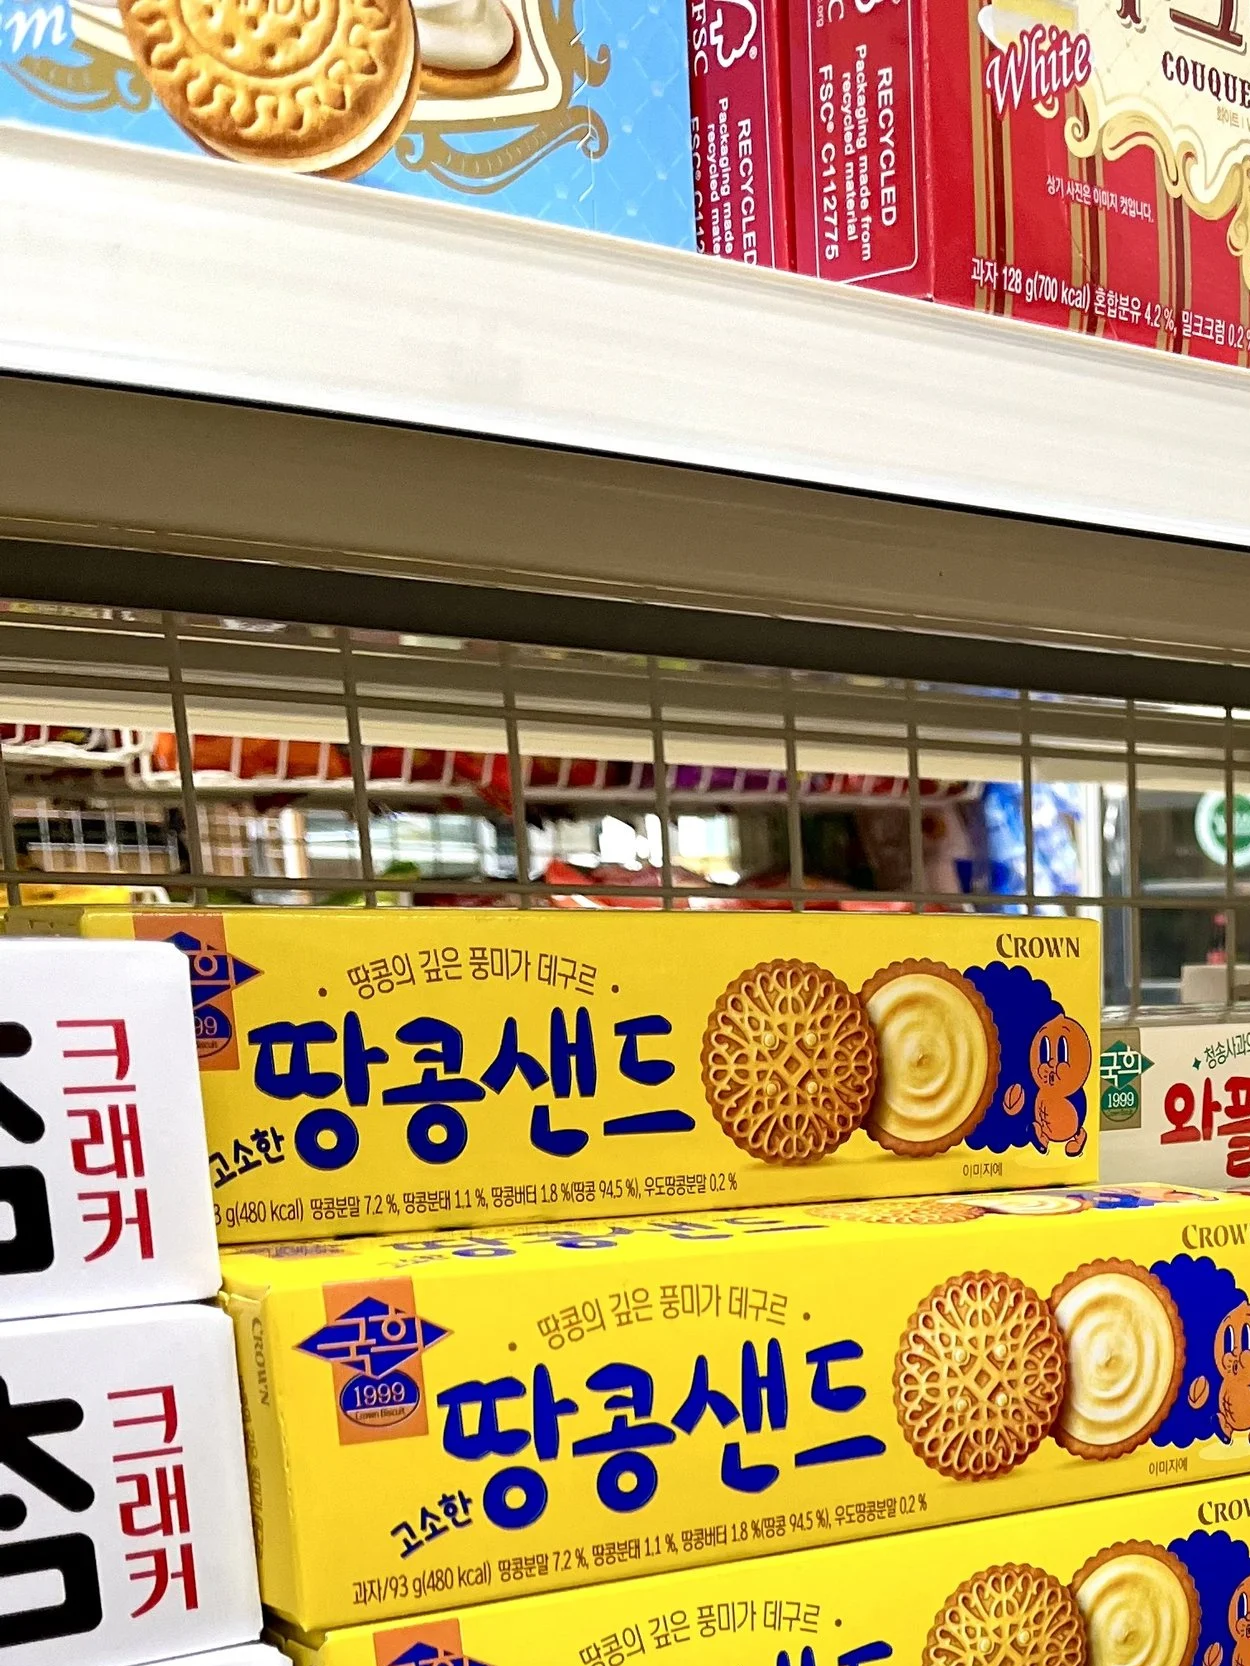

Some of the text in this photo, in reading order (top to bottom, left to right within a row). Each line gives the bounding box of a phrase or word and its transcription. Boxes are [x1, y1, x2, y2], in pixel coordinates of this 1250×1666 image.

[985, 25, 1092, 116] White
[841, 71, 859, 242] recycled material
[855, 44, 872, 261] Packaging made from
[877, 66, 897, 227] RECYCLED
[1046, 174, 1065, 198] 상기
[1066, 179, 1092, 207] 사진은
[1093, 185, 1119, 213] 이미지
[821, 142, 840, 261] C112775
[970, 256, 999, 287] 과자
[1002, 269, 1024, 296] 128
[1025, 271, 1058, 303] g(700
[1061, 276, 1091, 308] kcal)
[1093, 287, 1142, 324] 혼합분유
[1144, 302, 1162, 329] 4.2
[1181, 309, 1226, 348] 밀크크럼
[1227, 323, 1244, 349] 0.2
[347, 946, 598, 1000] 땅콩의 깊은 풍미가 데구르
[996, 933, 1081, 960] CROWN
[248, 1006, 696, 1170] 땅콩샌드
[537, 1283, 789, 1351] 땅콩의 깊은 풍미가 데구르
[353, 1381, 407, 1409] 1999
[436, 1337, 887, 1531] 땅콩샌드
[106, 1383, 200, 1620] 크래커
[352, 1493, 928, 1606] 과자/93 g(480 kcal) 땅콩분말 7.2 %, 땅콩분태 1.1 %, 땅콩버터 1.8 %(땅콩 94.5 %), 우도땅콩분말 0.2 %
[390, 1488, 473, 1560] 고소한
